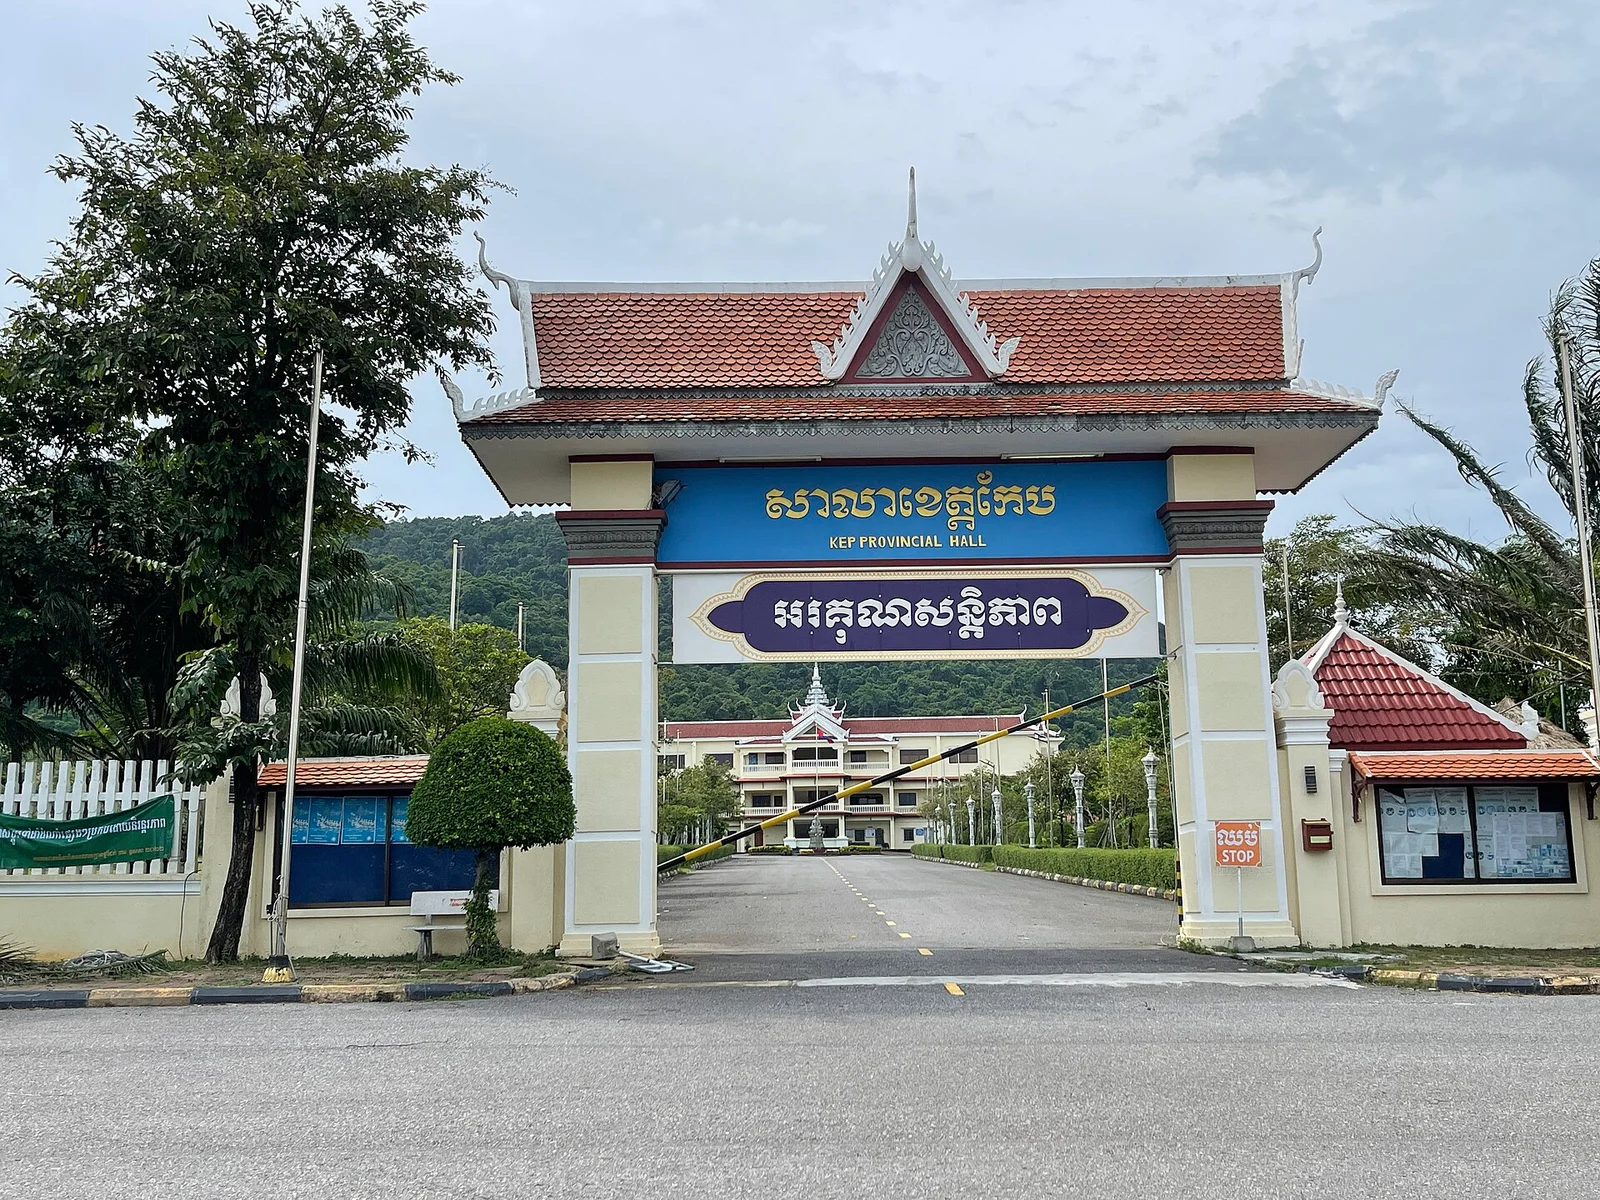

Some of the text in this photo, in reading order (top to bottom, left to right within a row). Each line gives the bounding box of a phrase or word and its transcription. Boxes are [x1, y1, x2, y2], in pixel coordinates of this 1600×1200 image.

[764, 469, 1056, 532] សាលាខេត្តកែប
[829, 534, 987, 549] KEP PROVINCIAL HALL
[773, 586, 1062, 645] អរគុណសន្តិភាព
[1217, 823, 1259, 847] ឈប់
[1222, 849, 1255, 864] STOP
